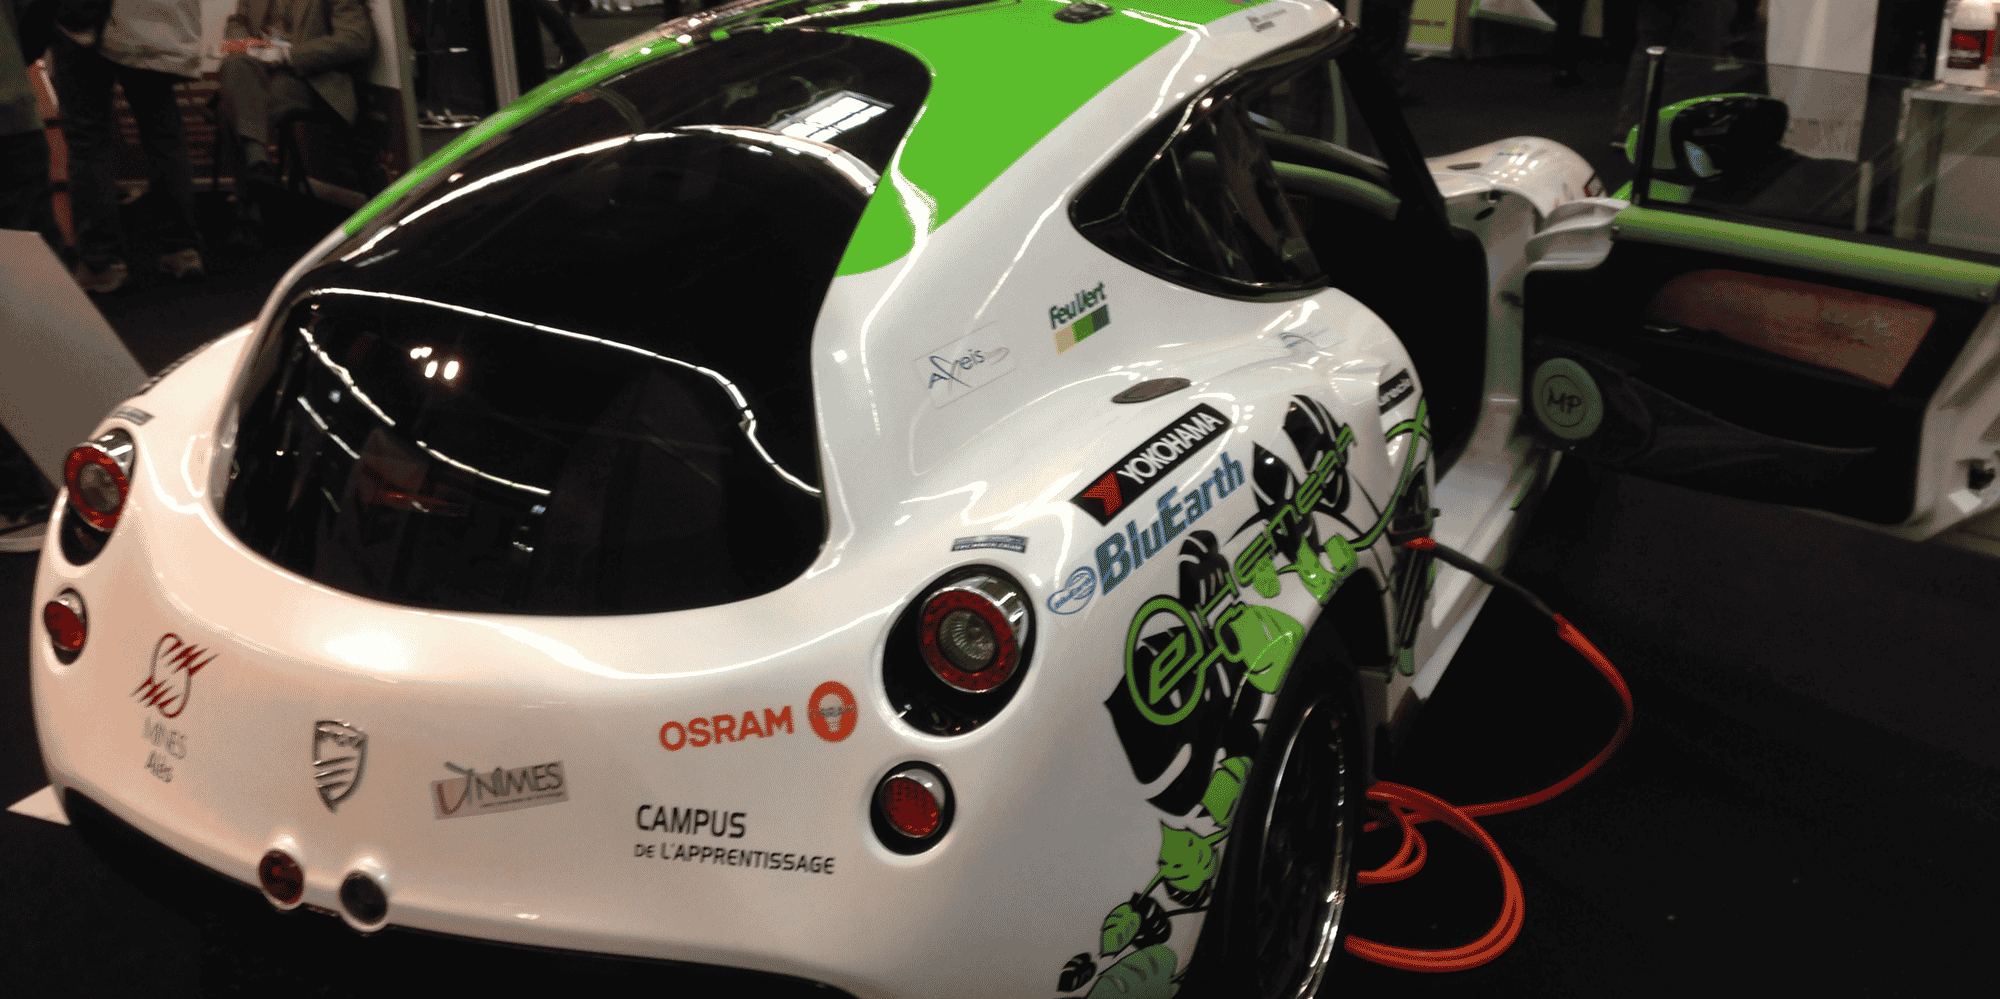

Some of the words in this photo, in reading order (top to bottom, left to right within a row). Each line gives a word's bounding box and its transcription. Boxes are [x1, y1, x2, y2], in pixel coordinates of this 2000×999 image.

[1546, 386, 1582, 415] MP
[1117, 411, 1225, 485] YOKOHAMA
[1094, 451, 1246, 596] BluEarth
[658, 704, 795, 751] OSRAM
[635, 804, 748, 839] CAMPUS
[659, 842, 837, 876] L'APPRENTISSAGE
